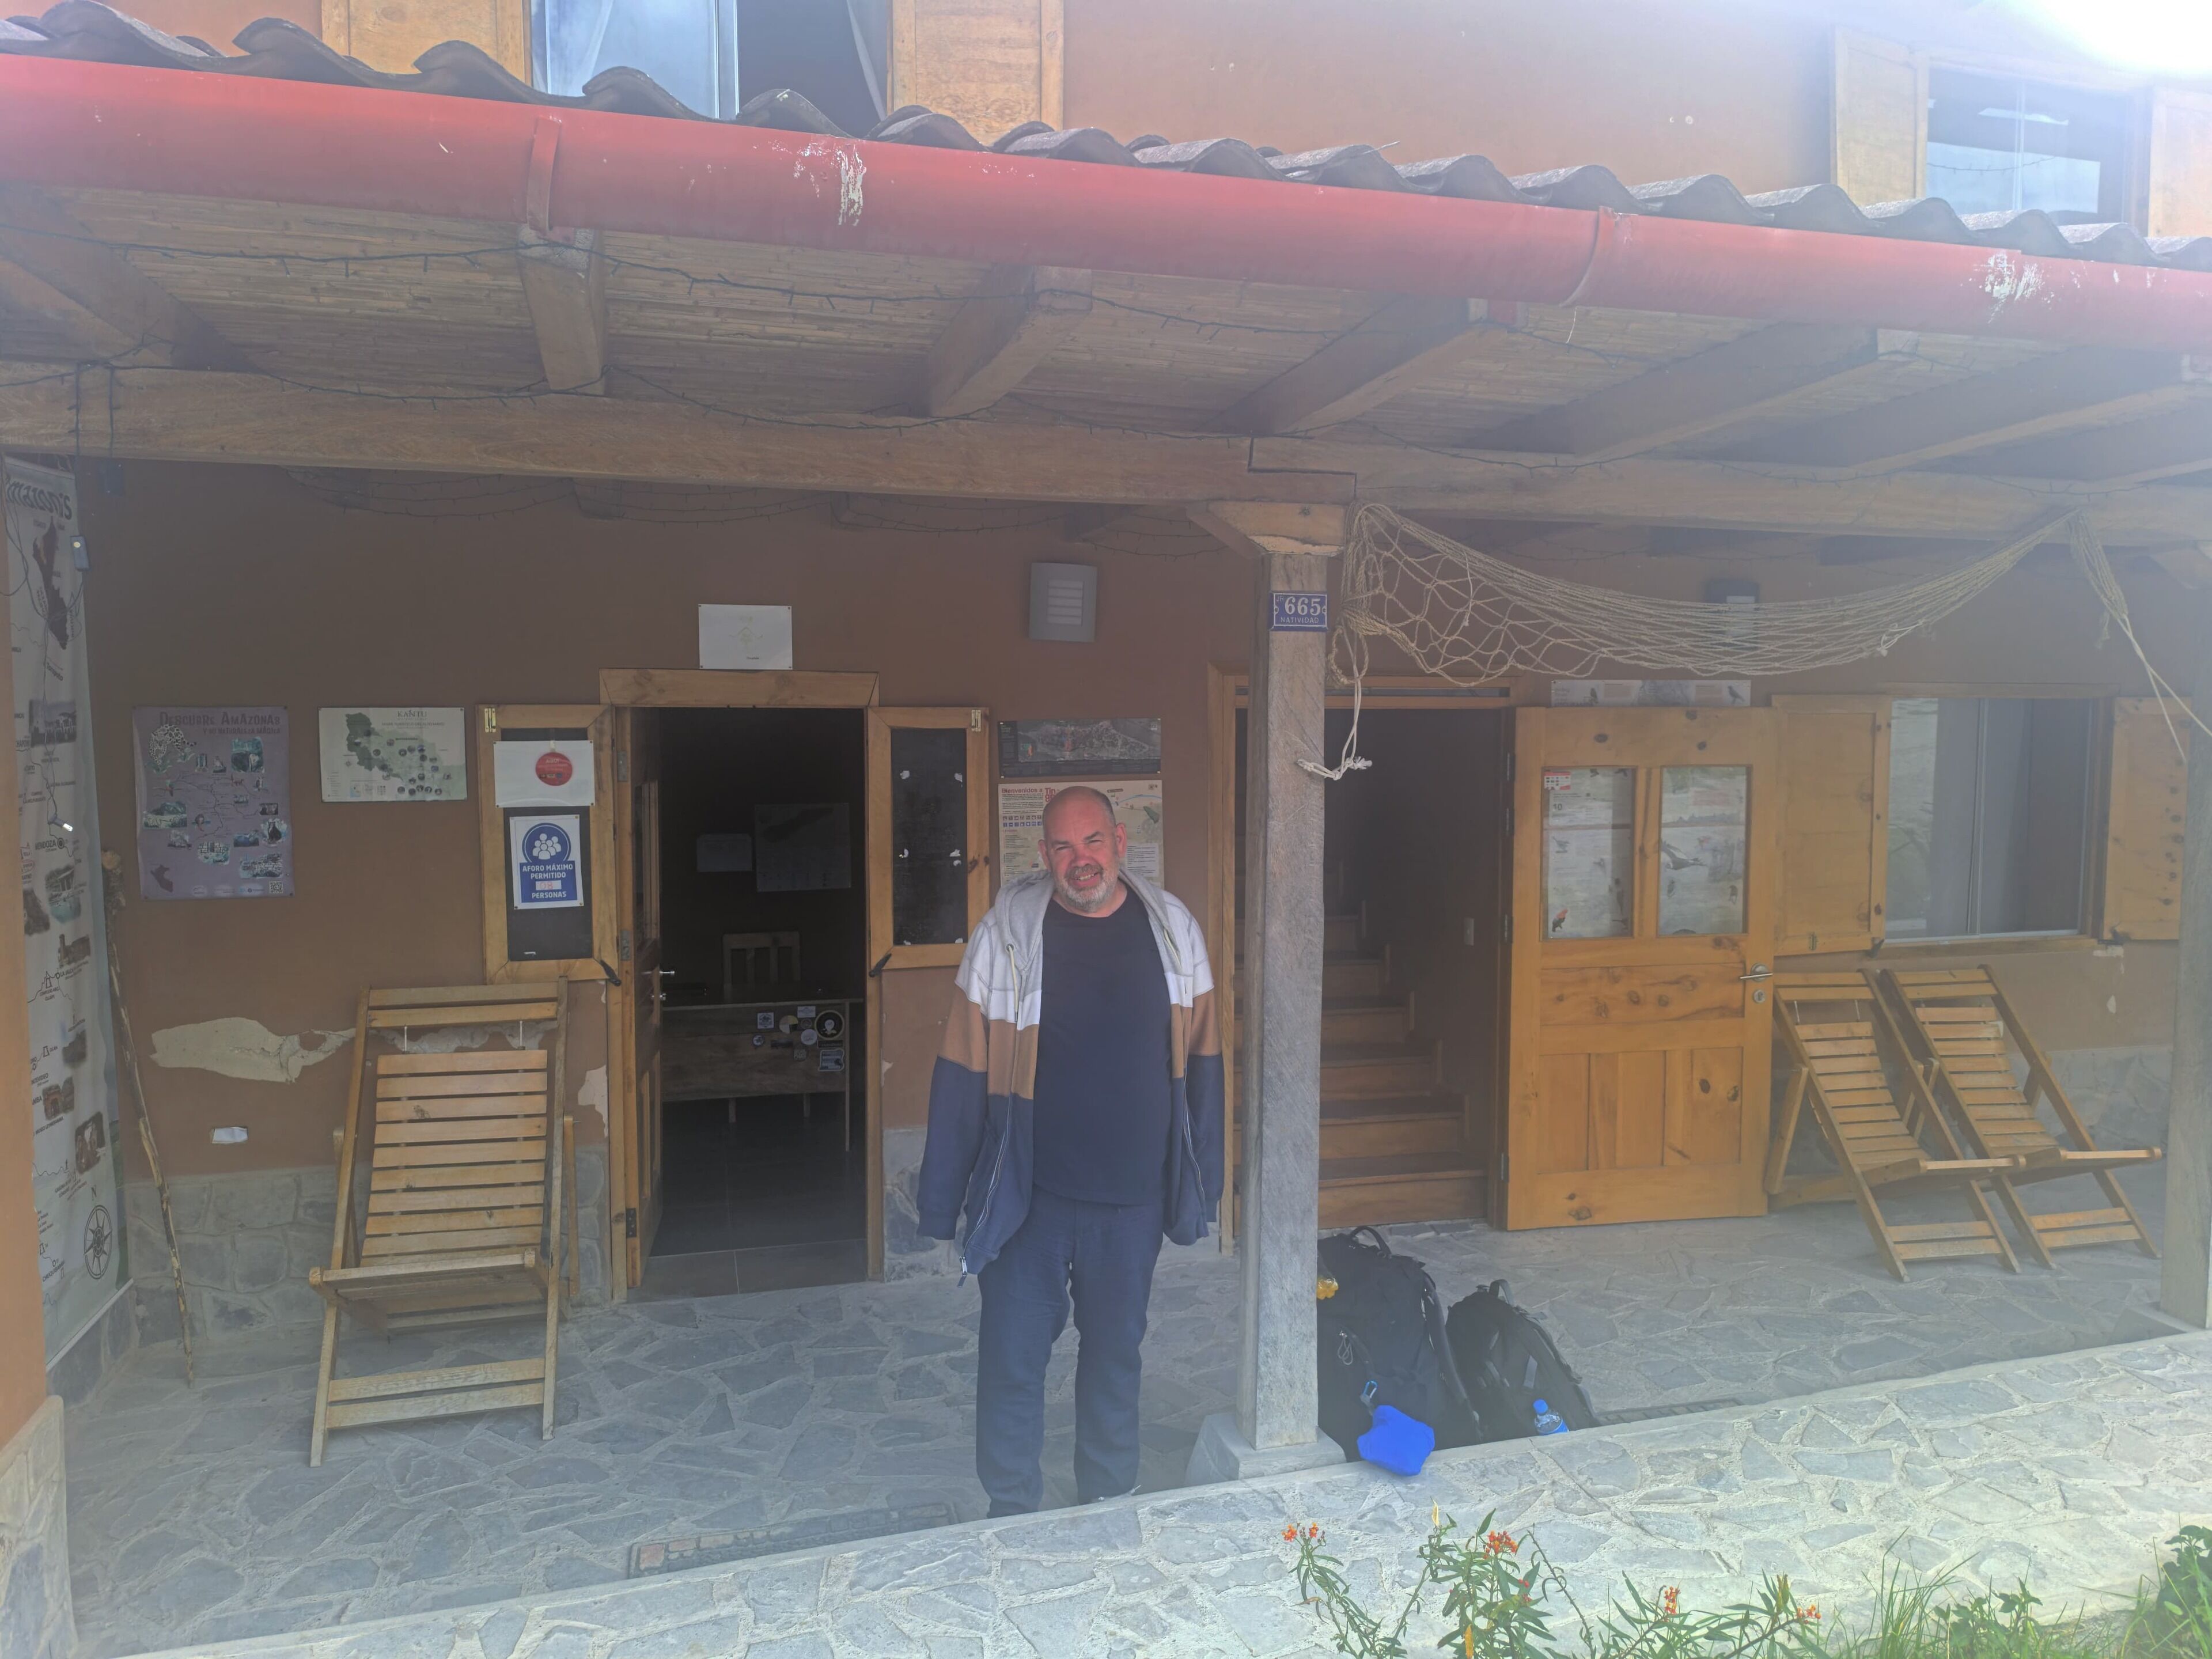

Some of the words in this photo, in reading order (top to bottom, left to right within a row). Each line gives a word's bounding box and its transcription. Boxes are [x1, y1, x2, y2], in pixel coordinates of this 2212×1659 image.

[1285, 596, 1320, 615] 665
[160, 711, 215, 725] DESCUBRE
[221, 711, 281, 725] AMAZONAS
[35, 839, 57, 850] MENDOZA
[522, 863, 545, 872] AFORO
[546, 862, 573, 872] MÁXIMO
[531, 871, 566, 879] PERMITIDO
[540, 881, 554, 890] 08
[531, 891, 567, 899] PERSONAS
[91, 1184, 97, 1200] N
